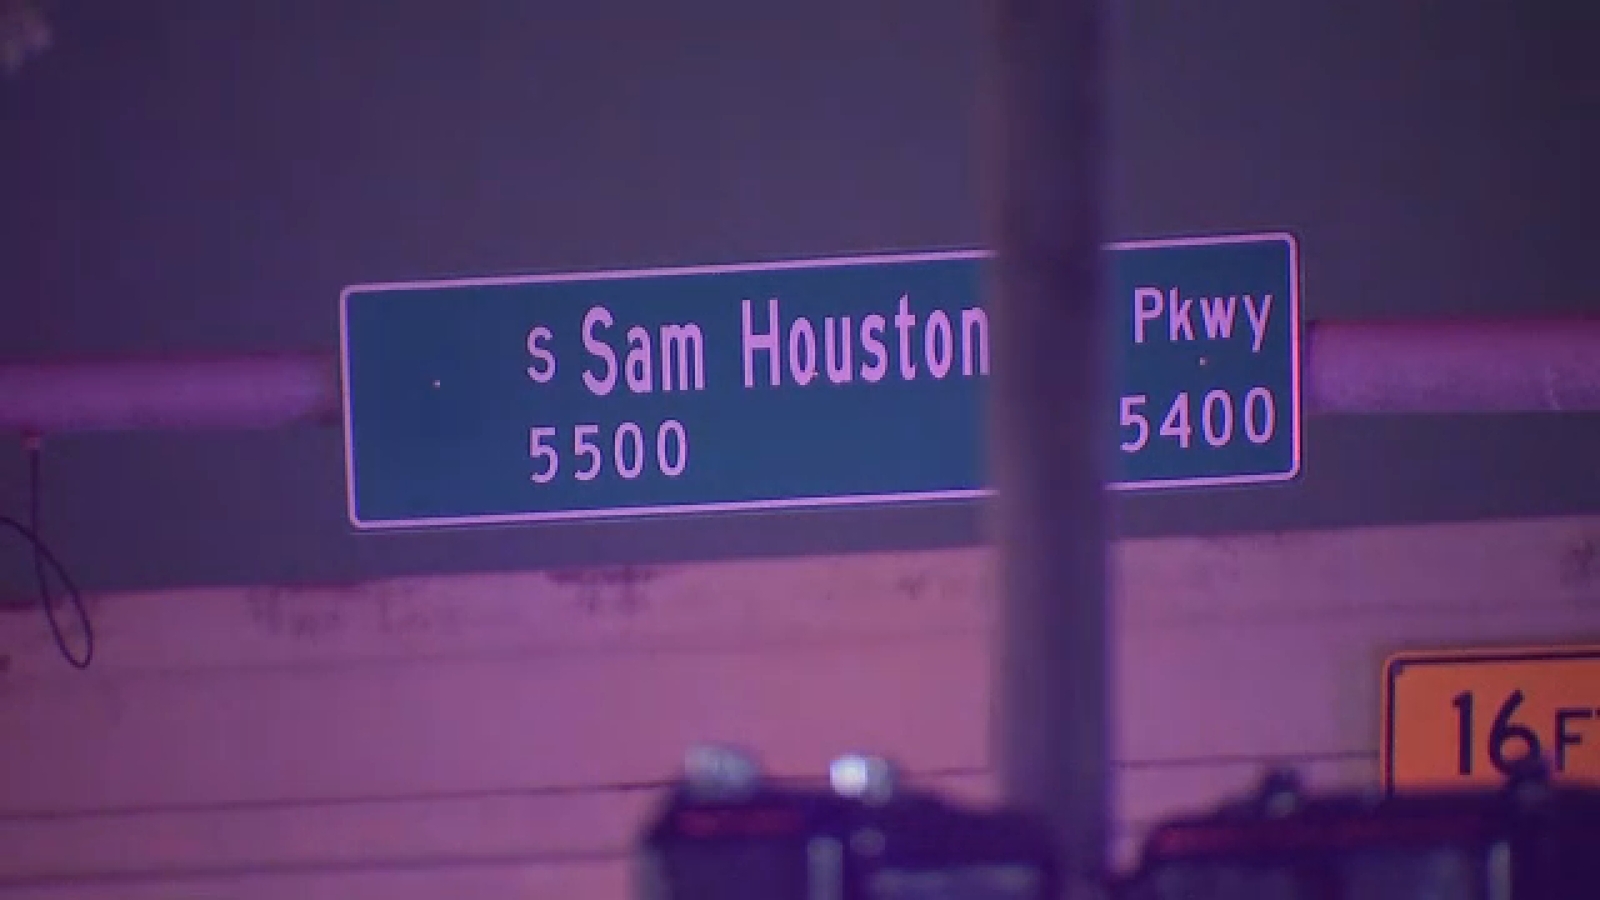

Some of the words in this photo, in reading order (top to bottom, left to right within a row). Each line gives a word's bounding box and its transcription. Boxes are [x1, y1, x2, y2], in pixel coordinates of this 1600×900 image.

[581, 304, 706, 396] Sam
[741, 293, 990, 388] Houston
[1133, 286, 1274, 353] Pkwy
[529, 418, 688, 484] 5500
[1119, 386, 1277, 453] 5400
[1452, 689, 1541, 777] 16
[1554, 707, 1600, 773] F
